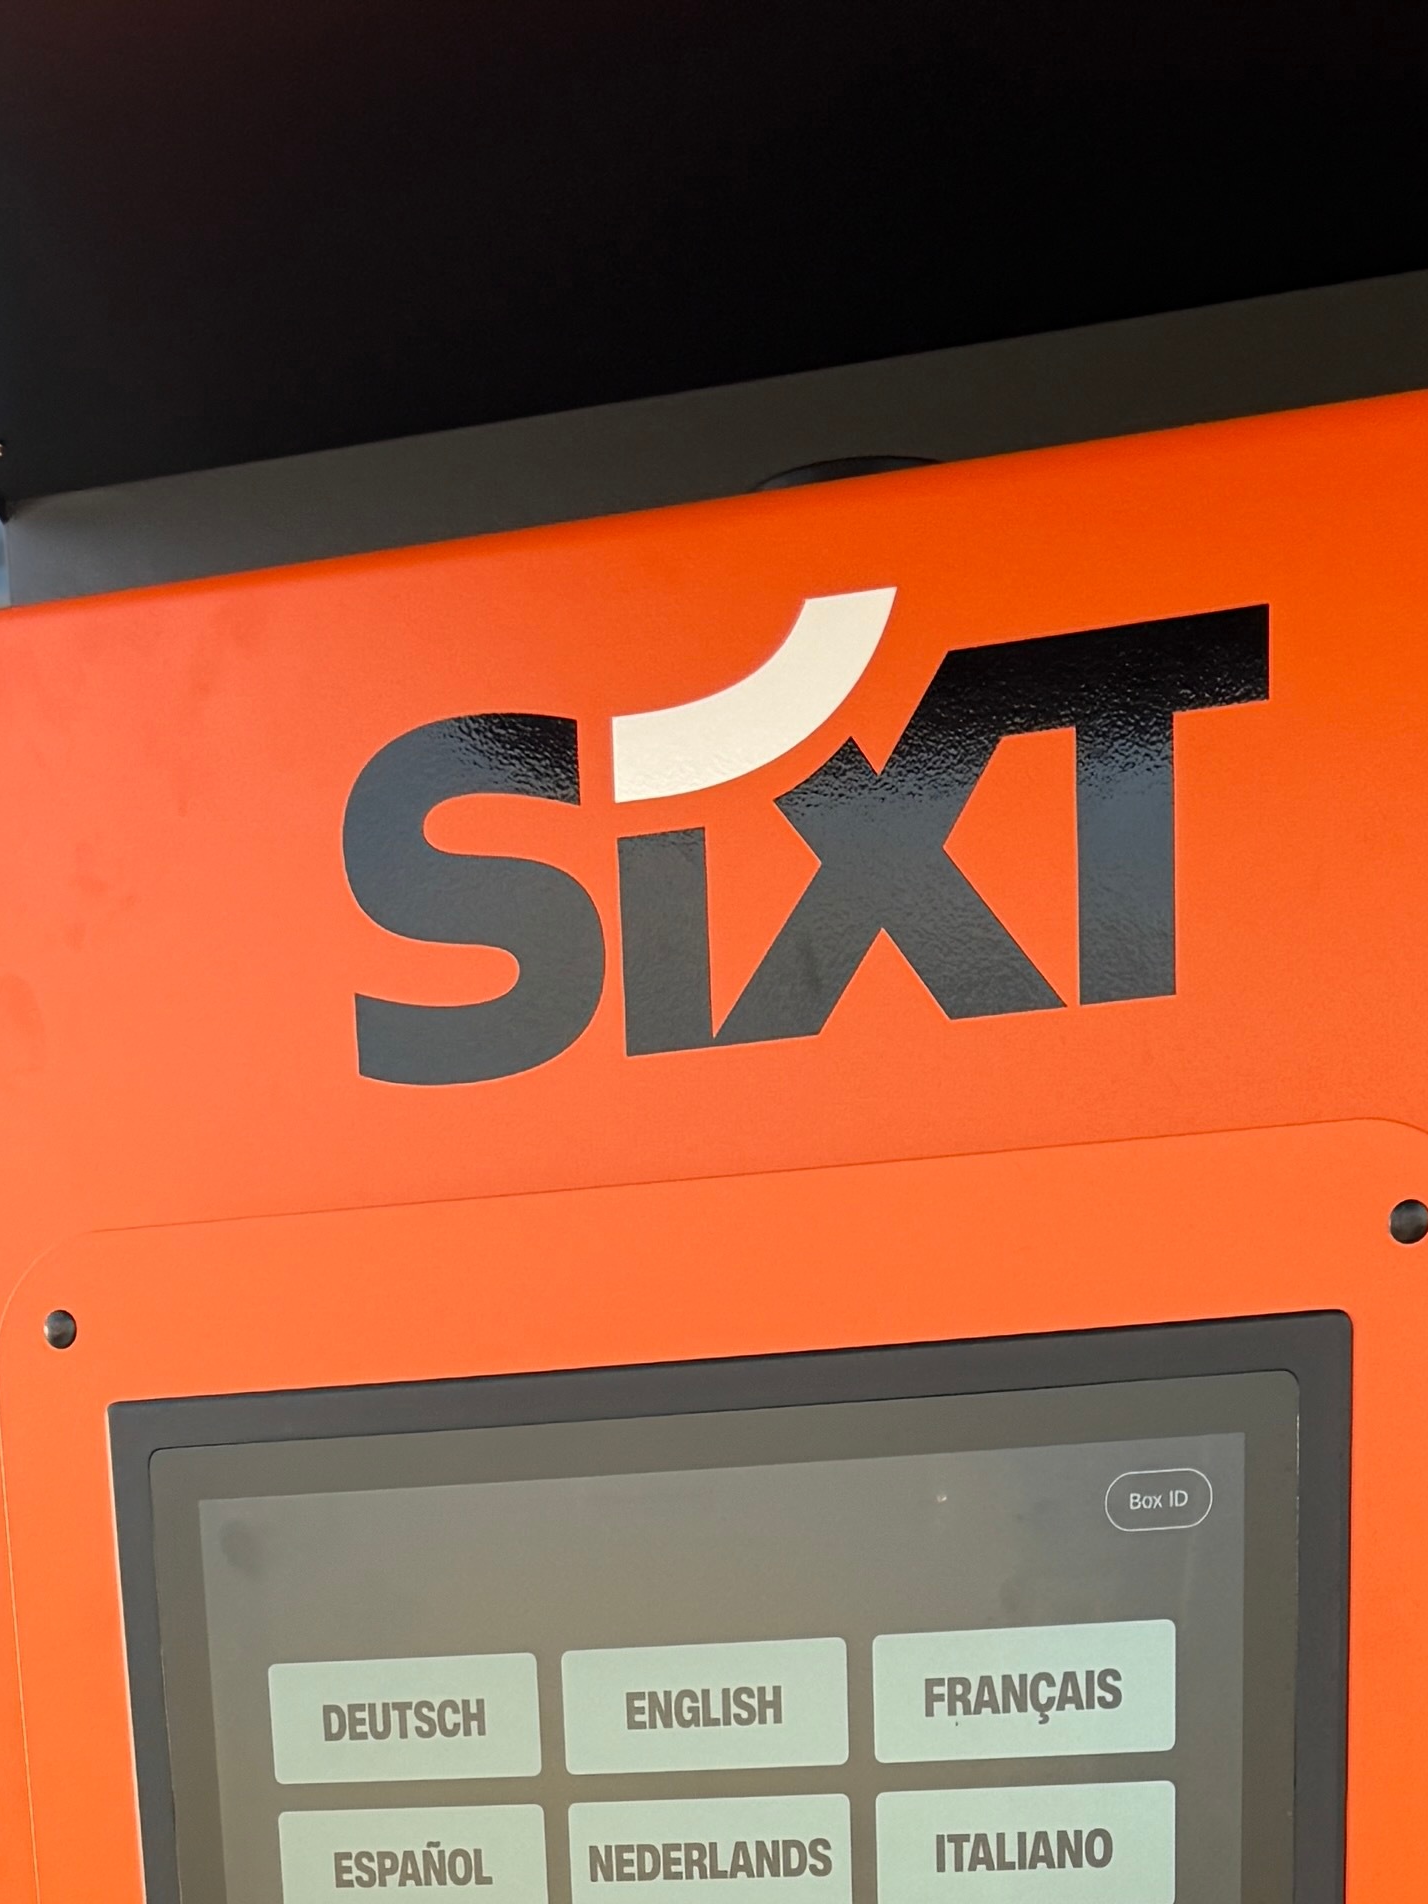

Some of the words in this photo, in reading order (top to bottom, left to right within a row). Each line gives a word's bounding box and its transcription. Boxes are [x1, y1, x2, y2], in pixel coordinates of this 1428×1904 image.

[1129, 1492, 1163, 1510] Box
[1169, 1489, 1189, 1508] ID
[322, 1697, 487, 1743] DEUTSCH
[625, 1685, 783, 1731] ENGLISH
[923, 1668, 1123, 1726] FRANÇAIS
[333, 1840, 493, 1889] ESPAÑOL
[587, 1838, 833, 1883] NEDERLANDS
[935, 1827, 1114, 1873] ITALIANO
